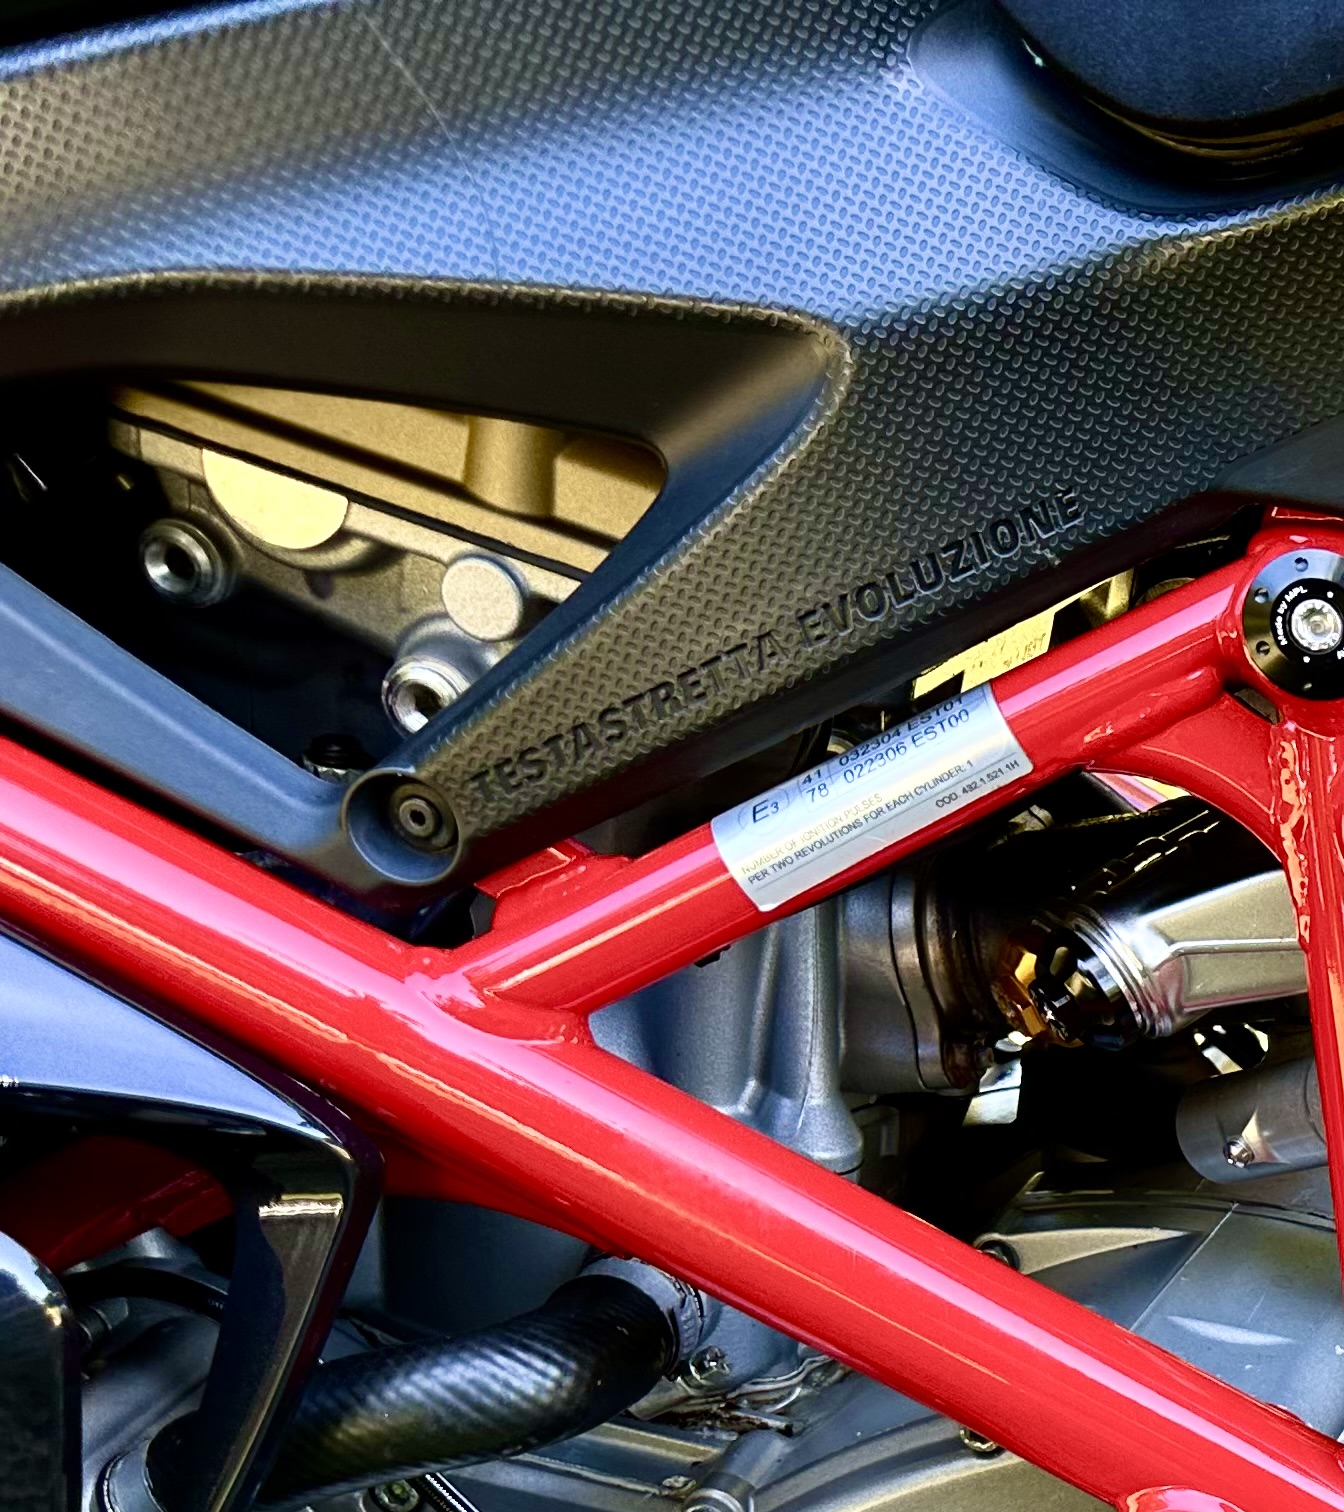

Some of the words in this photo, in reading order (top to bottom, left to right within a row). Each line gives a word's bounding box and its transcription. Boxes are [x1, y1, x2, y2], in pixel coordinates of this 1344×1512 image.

[470, 632, 788, 804] TESTASTRETTA
[797, 484, 1091, 647] EVOLUZIONE
[1275, 616, 1288, 646] Made
[1277, 601, 1288, 614] by
[805, 781, 831, 803] 78
[842, 739, 908, 785] 022306
[911, 707, 971, 748] EST00
[740, 845, 784, 875] NUMBER
[783, 838, 798, 852] OF
[799, 813, 843, 844] IGNITION
[842, 791, 883, 819] PULSES
[747, 867, 770, 885] PER
[770, 854, 795, 873] TWO
[793, 817, 864, 860] REVOLUTIONS
[863, 804, 885, 823] FOR
[885, 790, 914, 811] EACH
[965, 758, 973, 768] 1
